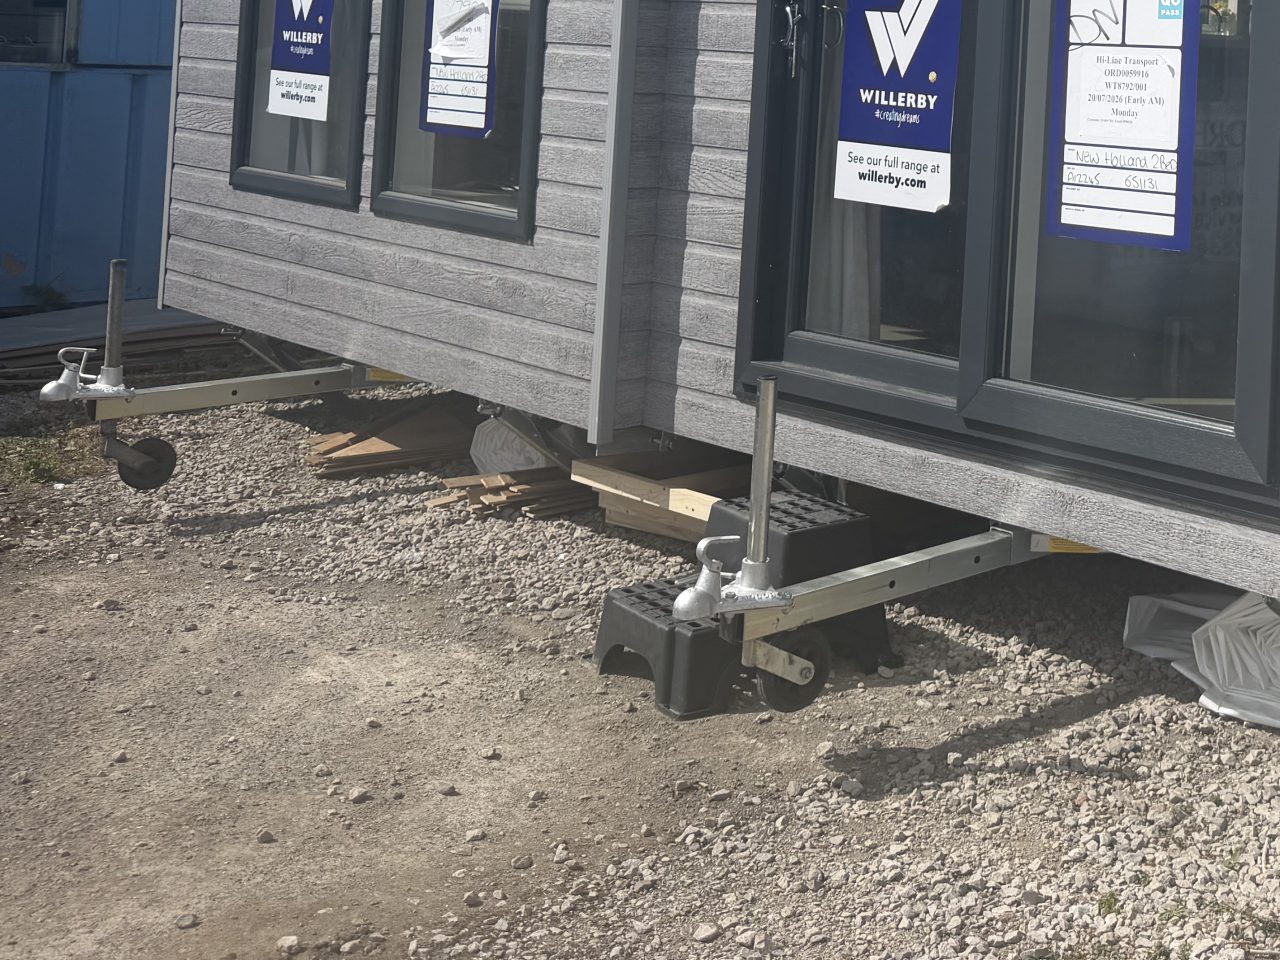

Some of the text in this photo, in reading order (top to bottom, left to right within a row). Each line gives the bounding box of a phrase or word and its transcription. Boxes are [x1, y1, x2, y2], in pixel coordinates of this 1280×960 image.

[282, 30, 324, 44] WILLERBY
[1096, 56, 1158, 67] Hi-Line Transport
[276, 78, 284, 86] See
[294, 80, 302, 90] full
[302, 82, 317, 93] range
[318, 84, 324, 92] at
[280, 90, 316, 104] willerby.com
[860, 88, 938, 110] WILLERBY
[1124, 96, 1146, 106] (Early
[1148, 97, 1165, 106] AM)
[1110, 108, 1138, 119] Monday
[848, 152, 940, 174] See our full range at
[858, 170, 926, 188] willerby.com
